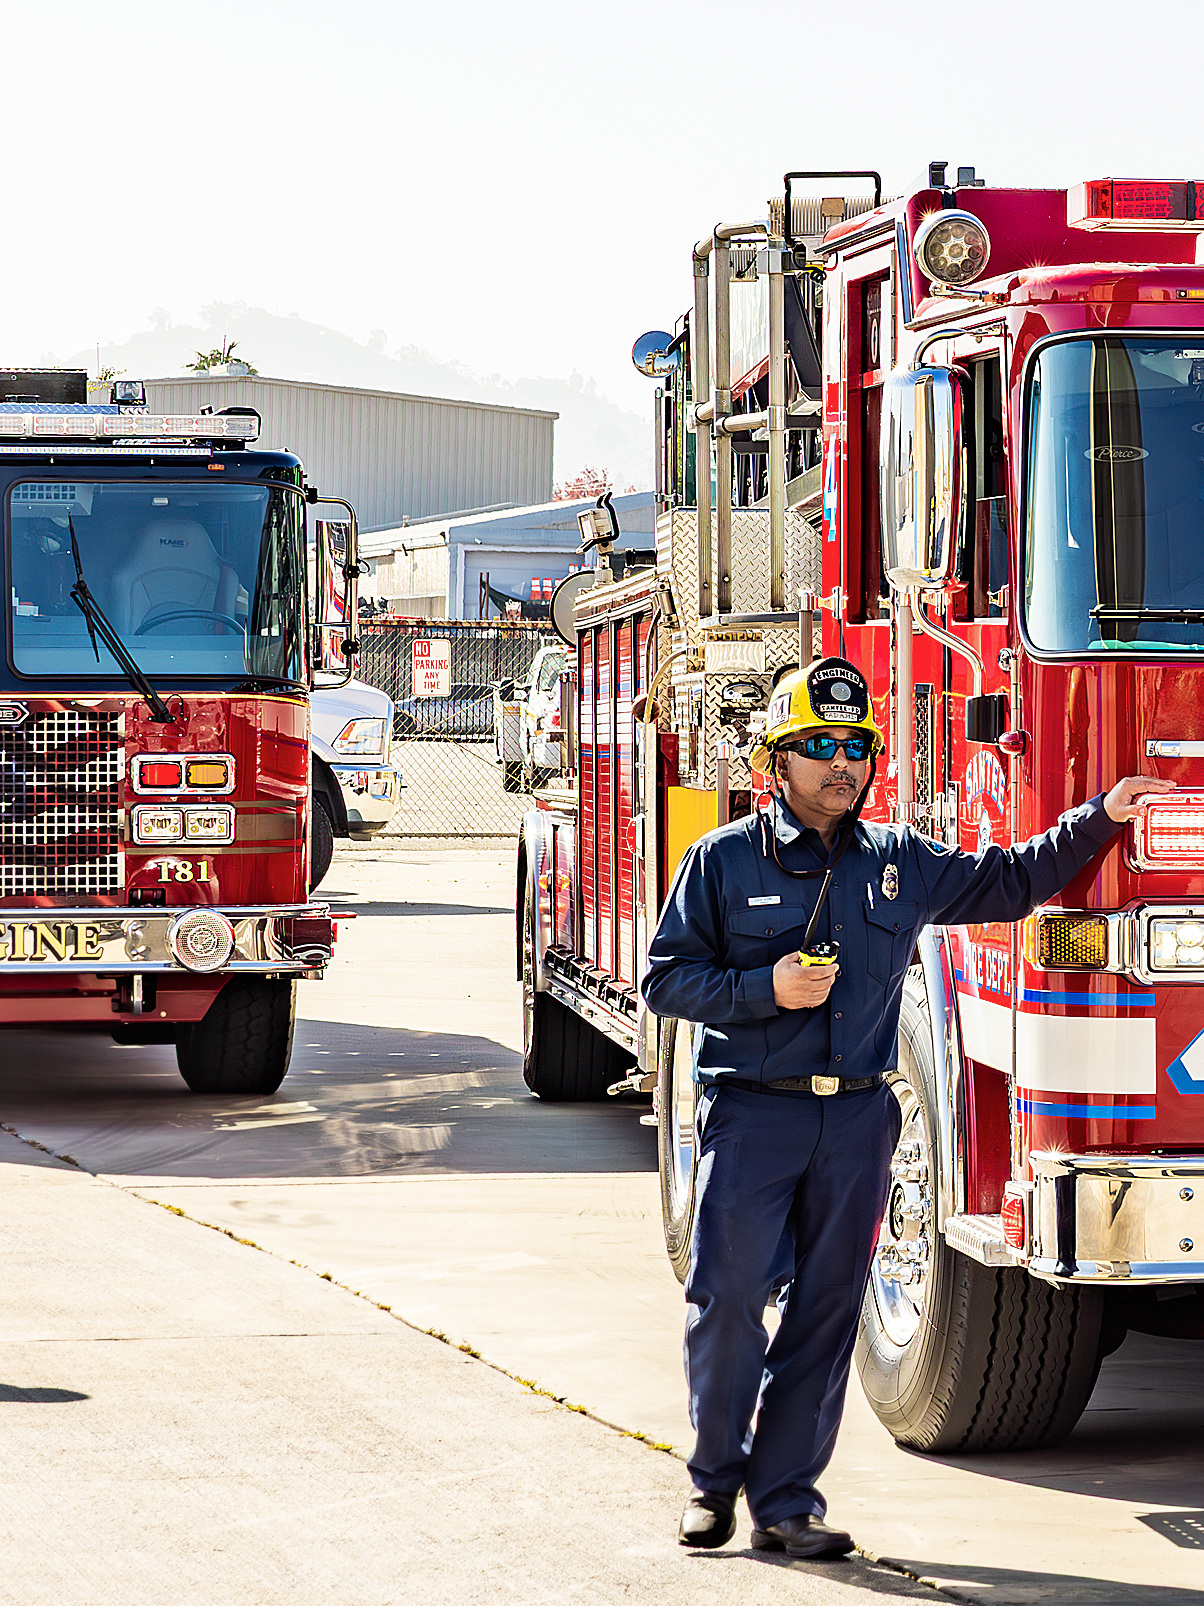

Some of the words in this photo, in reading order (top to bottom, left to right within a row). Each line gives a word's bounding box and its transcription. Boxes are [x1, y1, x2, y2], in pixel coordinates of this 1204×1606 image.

[415, 642, 429, 656] NO
[415, 659, 449, 670] PARKING
[424, 671, 440, 679] ANY
[817, 668, 859, 684] ENGINEER
[423, 681, 441, 690] TIME
[966, 750, 1006, 816] SANTEE
[157, 860, 211, 883] 181
[963, 941, 983, 988] FIRE
